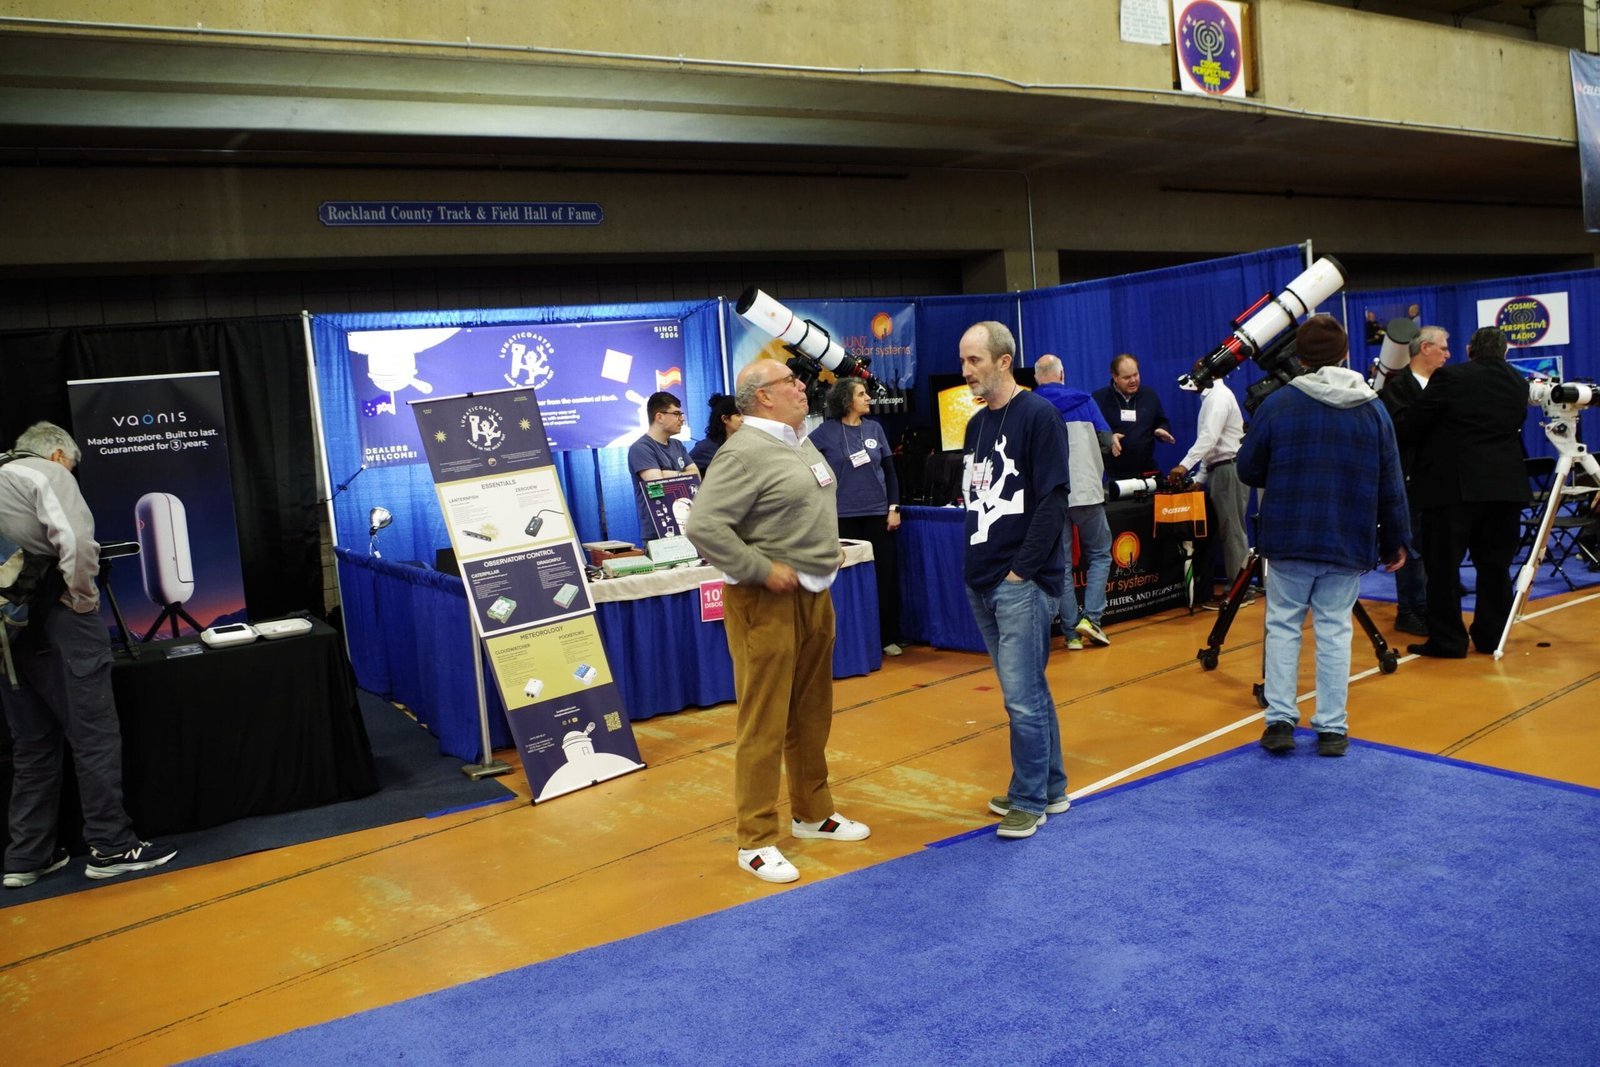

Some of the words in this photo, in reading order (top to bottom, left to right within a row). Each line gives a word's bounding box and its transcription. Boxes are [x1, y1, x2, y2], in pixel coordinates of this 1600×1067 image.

[327, 205, 386, 221] Rockland
[391, 205, 433, 223] County
[437, 206, 472, 221] Track
[476, 206, 486, 220] &
[491, 206, 519, 220] Field
[524, 206, 548, 220] Hall
[551, 207, 563, 220] of
[568, 207, 597, 220] Fame
[1507, 301, 1537, 311] COSMIC
[1500, 320, 1547, 332] PERSPECTIVE
[1510, 332, 1537, 340] RADIO
[499, 331, 555, 358] LUNATICOASTRO
[851, 345, 873, 356] solar
[876, 345, 912, 357] systems
[112, 411, 187, 427] vaonis
[460, 405, 503, 428] LUNATICOASTRO
[87, 437, 114, 446] Made
[127, 433, 164, 444] explore.
[165, 430, 188, 440] Built
[188, 429, 199, 437] to
[199, 428, 219, 436] last.
[100, 442, 155, 455] Guaranteed
[156, 442, 169, 450] for
[182, 440, 209, 449] years.
[365, 444, 408, 455] DEALERS
[366, 451, 417, 462] WELCOME!
[481, 479, 517, 490] ESSENTIALS
[483, 554, 526, 568] OBSERVATORY
[526, 549, 555, 559] CONTROL
[1118, 573, 1159, 592] systems
[1110, 595, 1135, 607] FILTERS,
[1136, 591, 1151, 601] AND
[520, 625, 563, 641] METEOROLOGY
